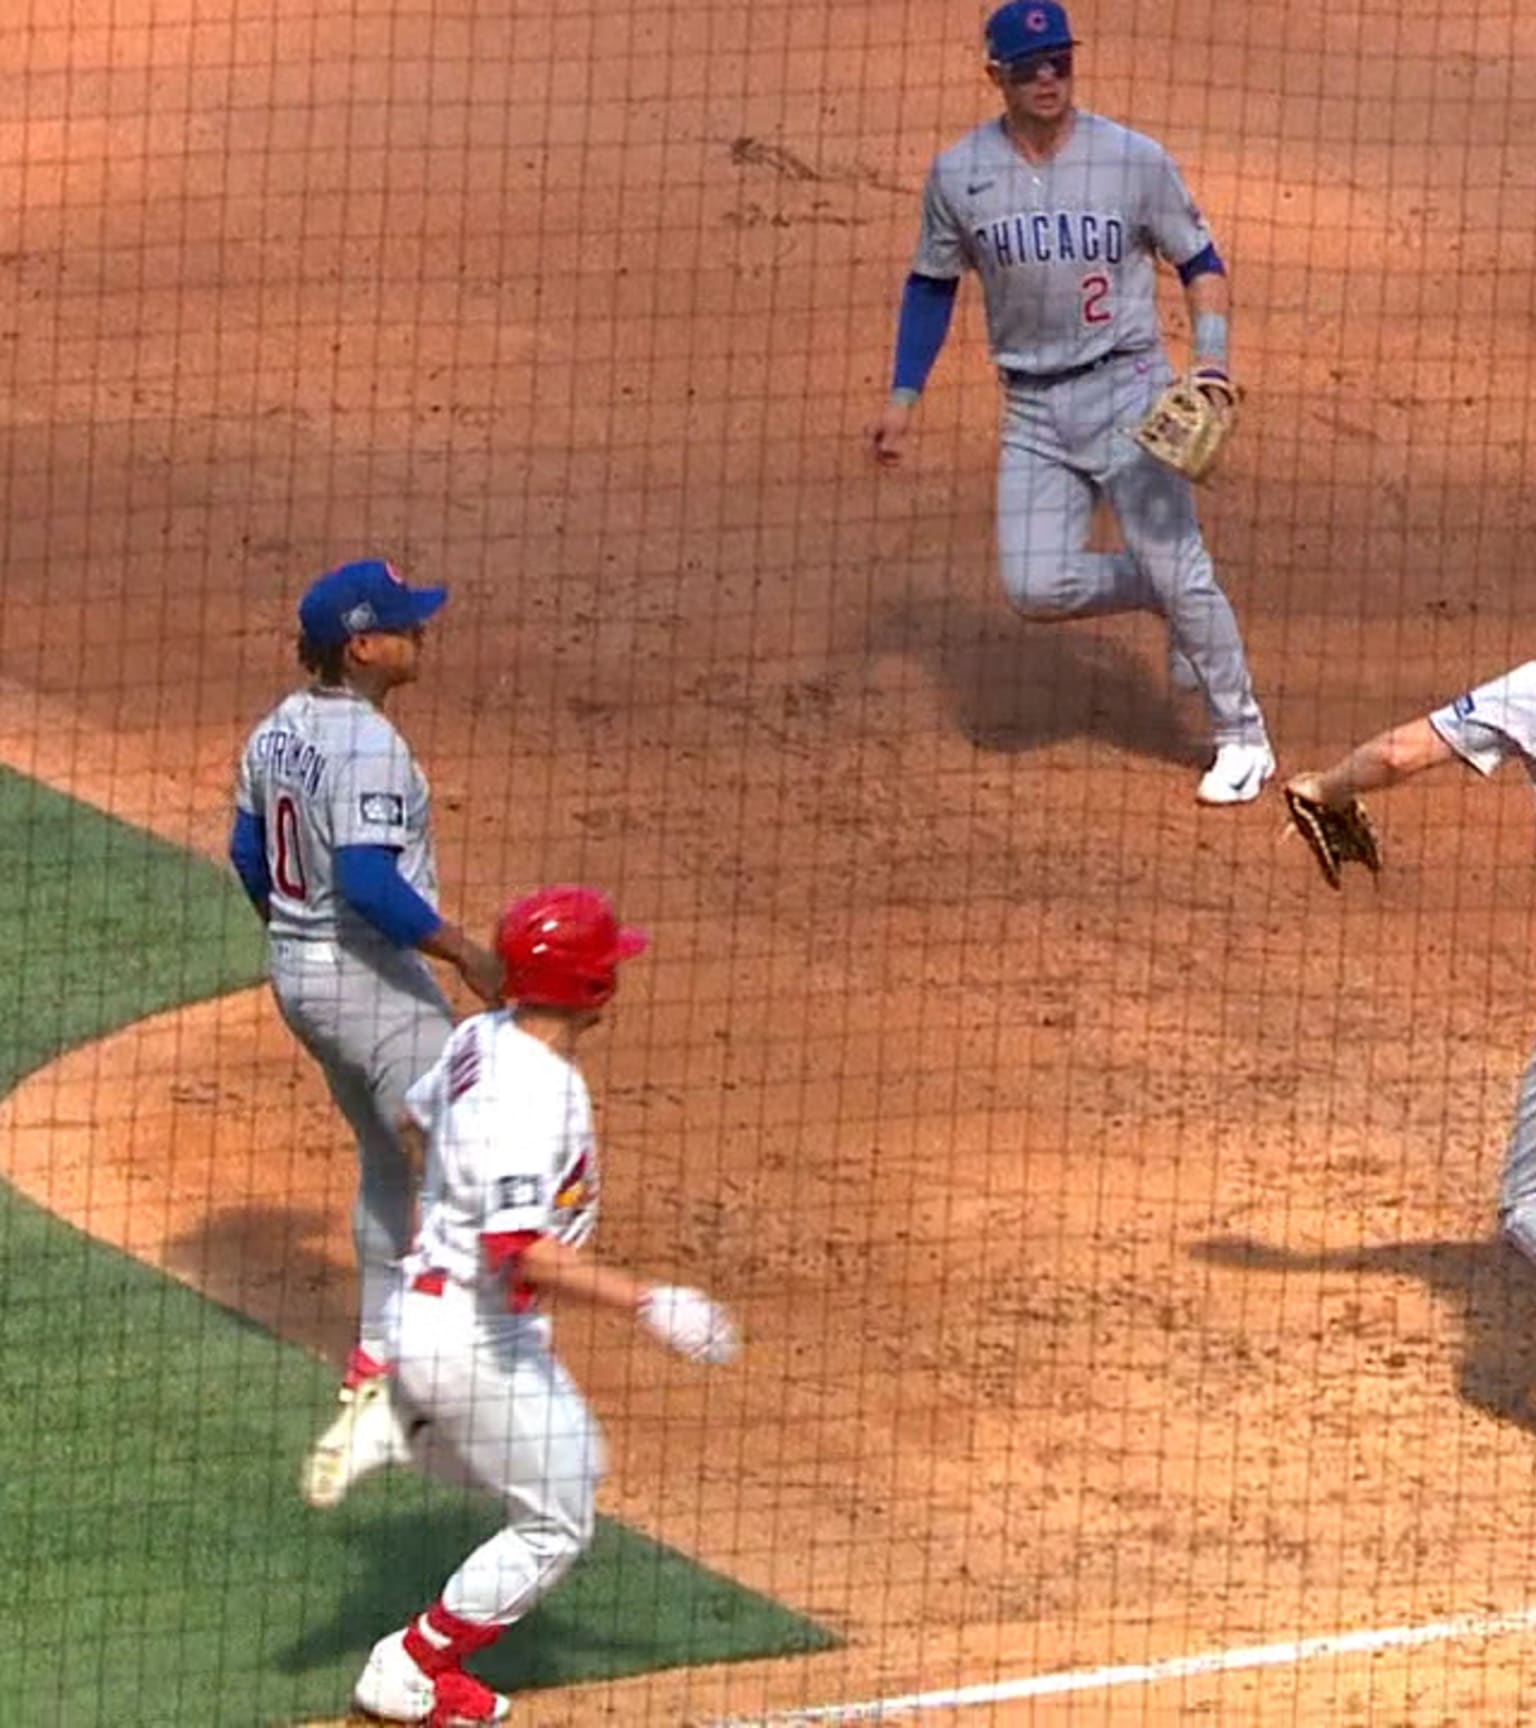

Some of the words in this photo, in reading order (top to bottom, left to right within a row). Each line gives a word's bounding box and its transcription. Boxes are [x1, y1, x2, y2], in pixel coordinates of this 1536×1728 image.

[975, 213, 1122, 268] CHICAGO
[1082, 276, 1111, 323] 2
[277, 796, 306, 900] 0
